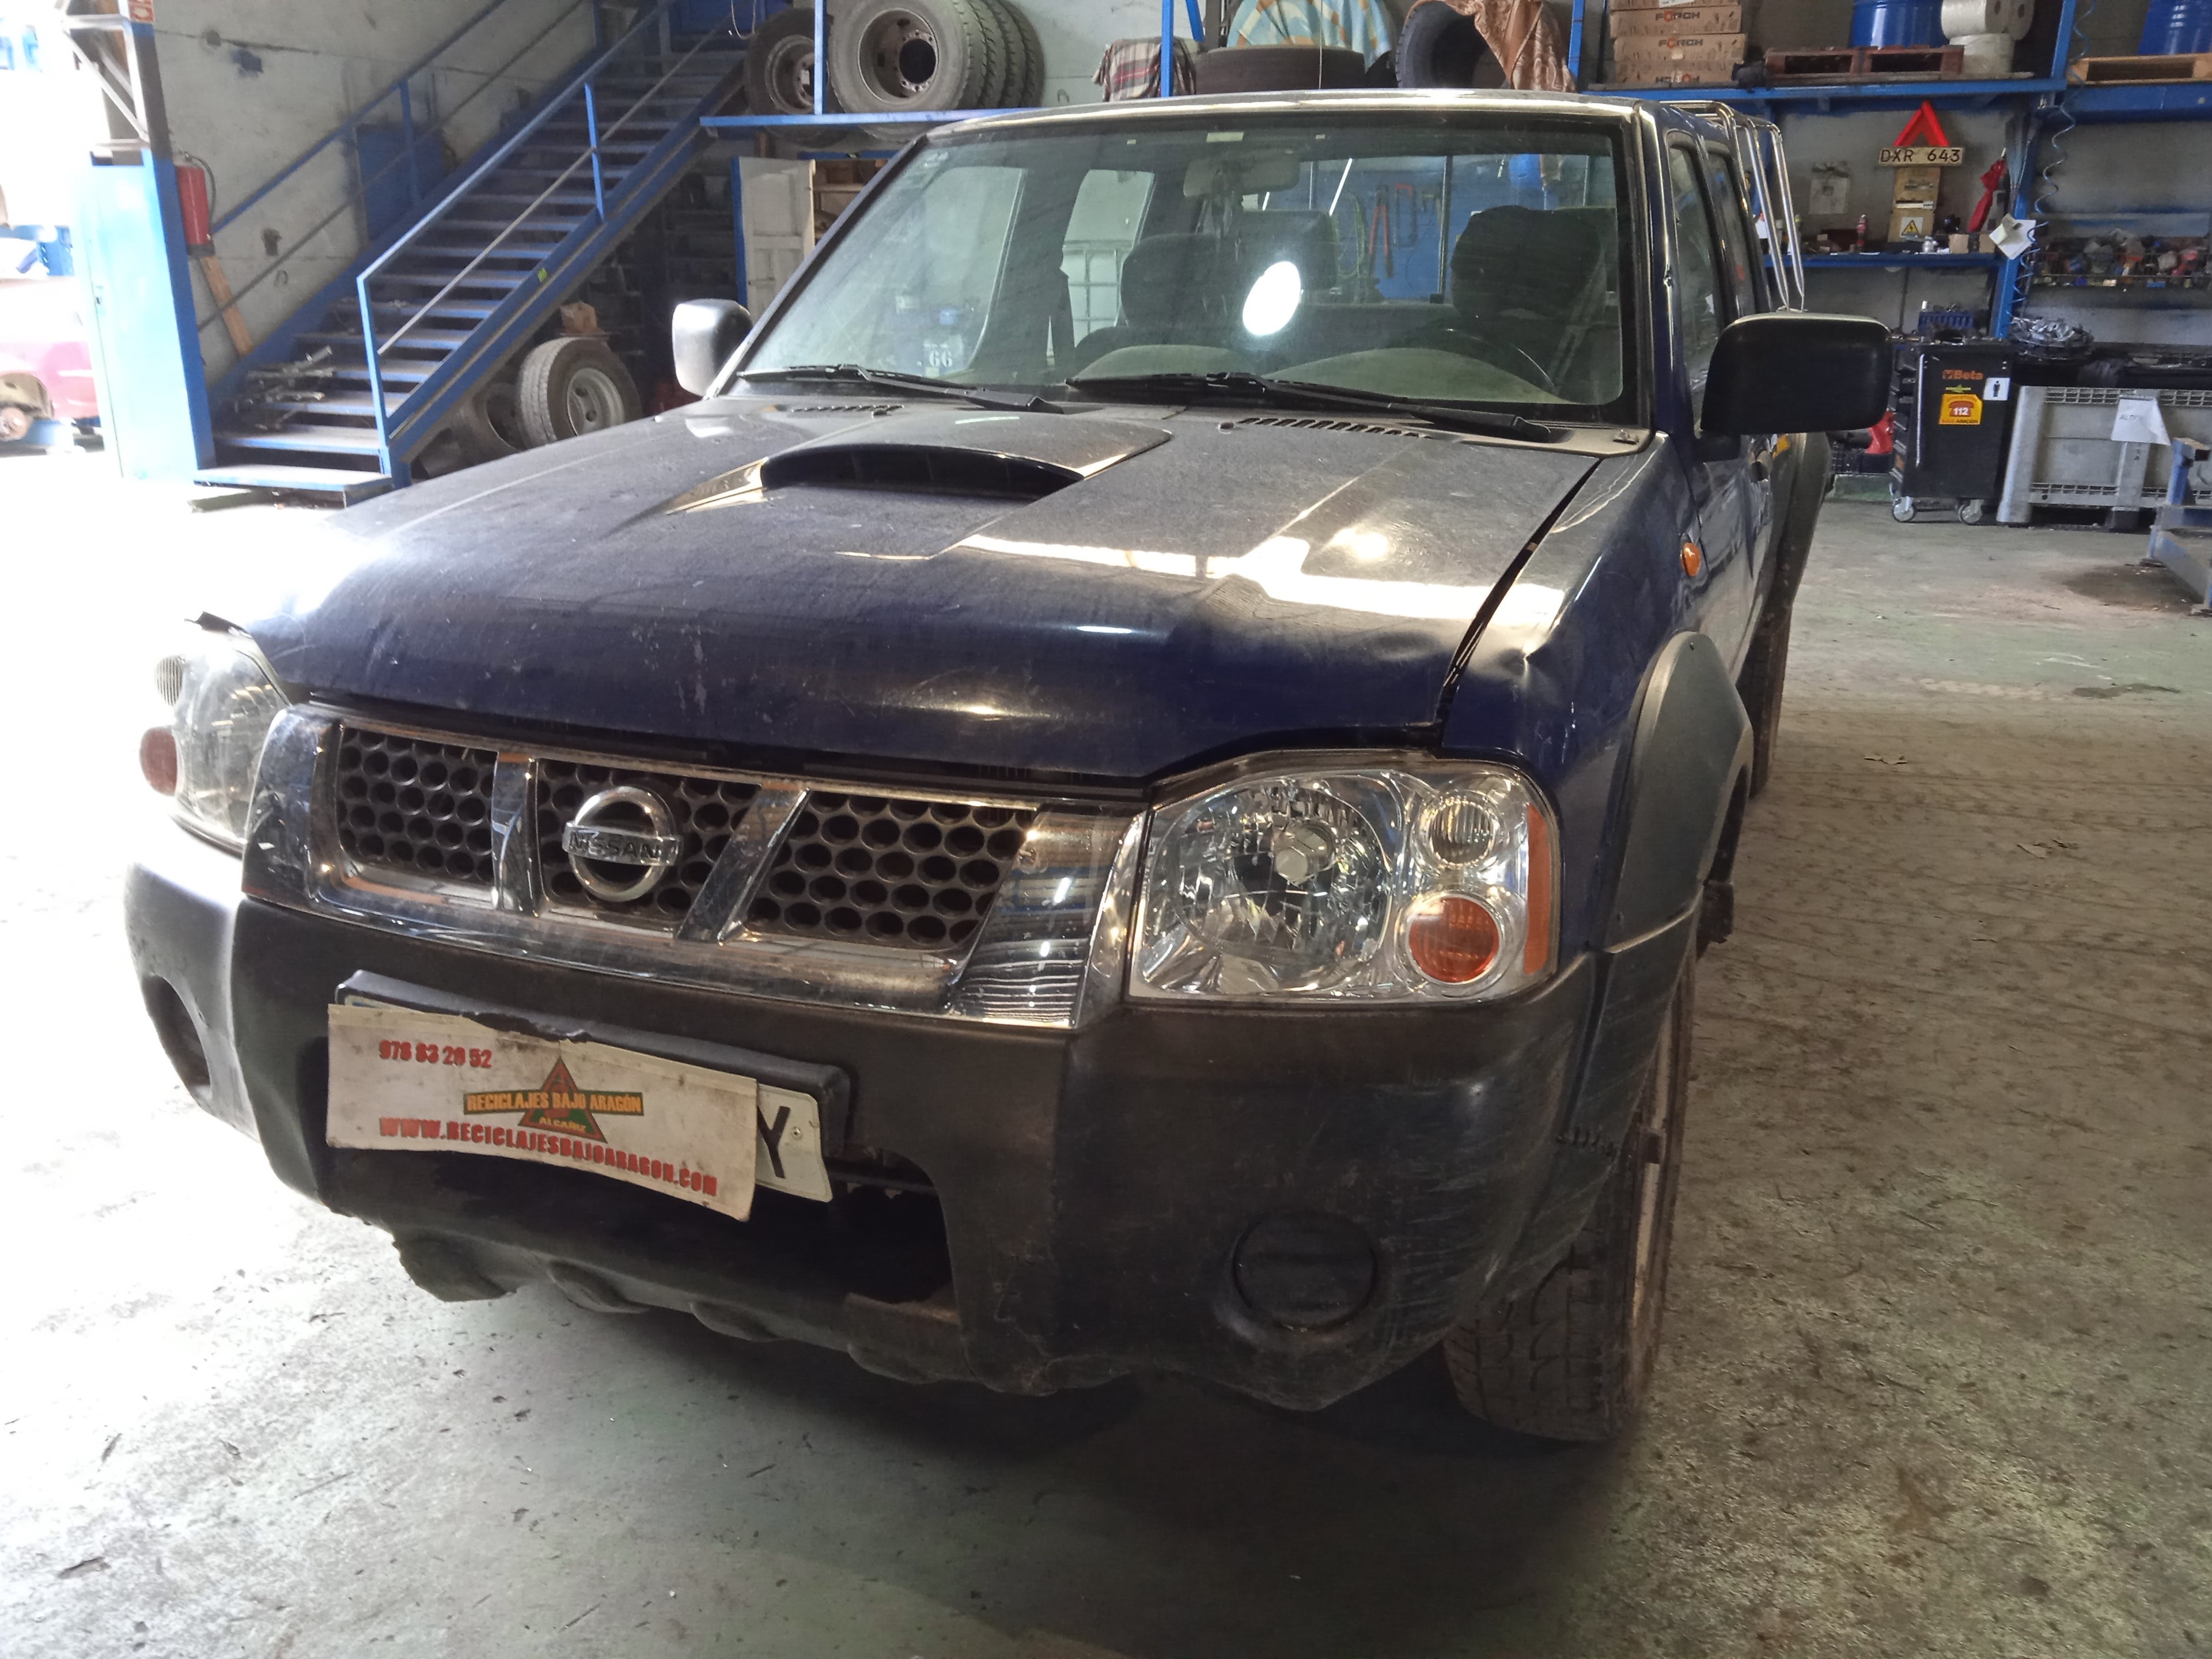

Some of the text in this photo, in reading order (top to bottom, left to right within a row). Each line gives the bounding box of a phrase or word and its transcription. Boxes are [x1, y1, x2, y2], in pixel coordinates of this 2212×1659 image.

[1880, 149, 1960, 162] DXR 643
[1953, 407, 1969, 415] 112
[568, 831, 662, 861] NISSAN
[378, 1039, 412, 1061] 978
[469, 1047, 493, 1069] 52
[467, 1091, 642, 1112] RECICLAJES BAJO ARAGÓN
[378, 1116, 718, 1196] WWW.RECICLAJESBAJOARAGON.COM
